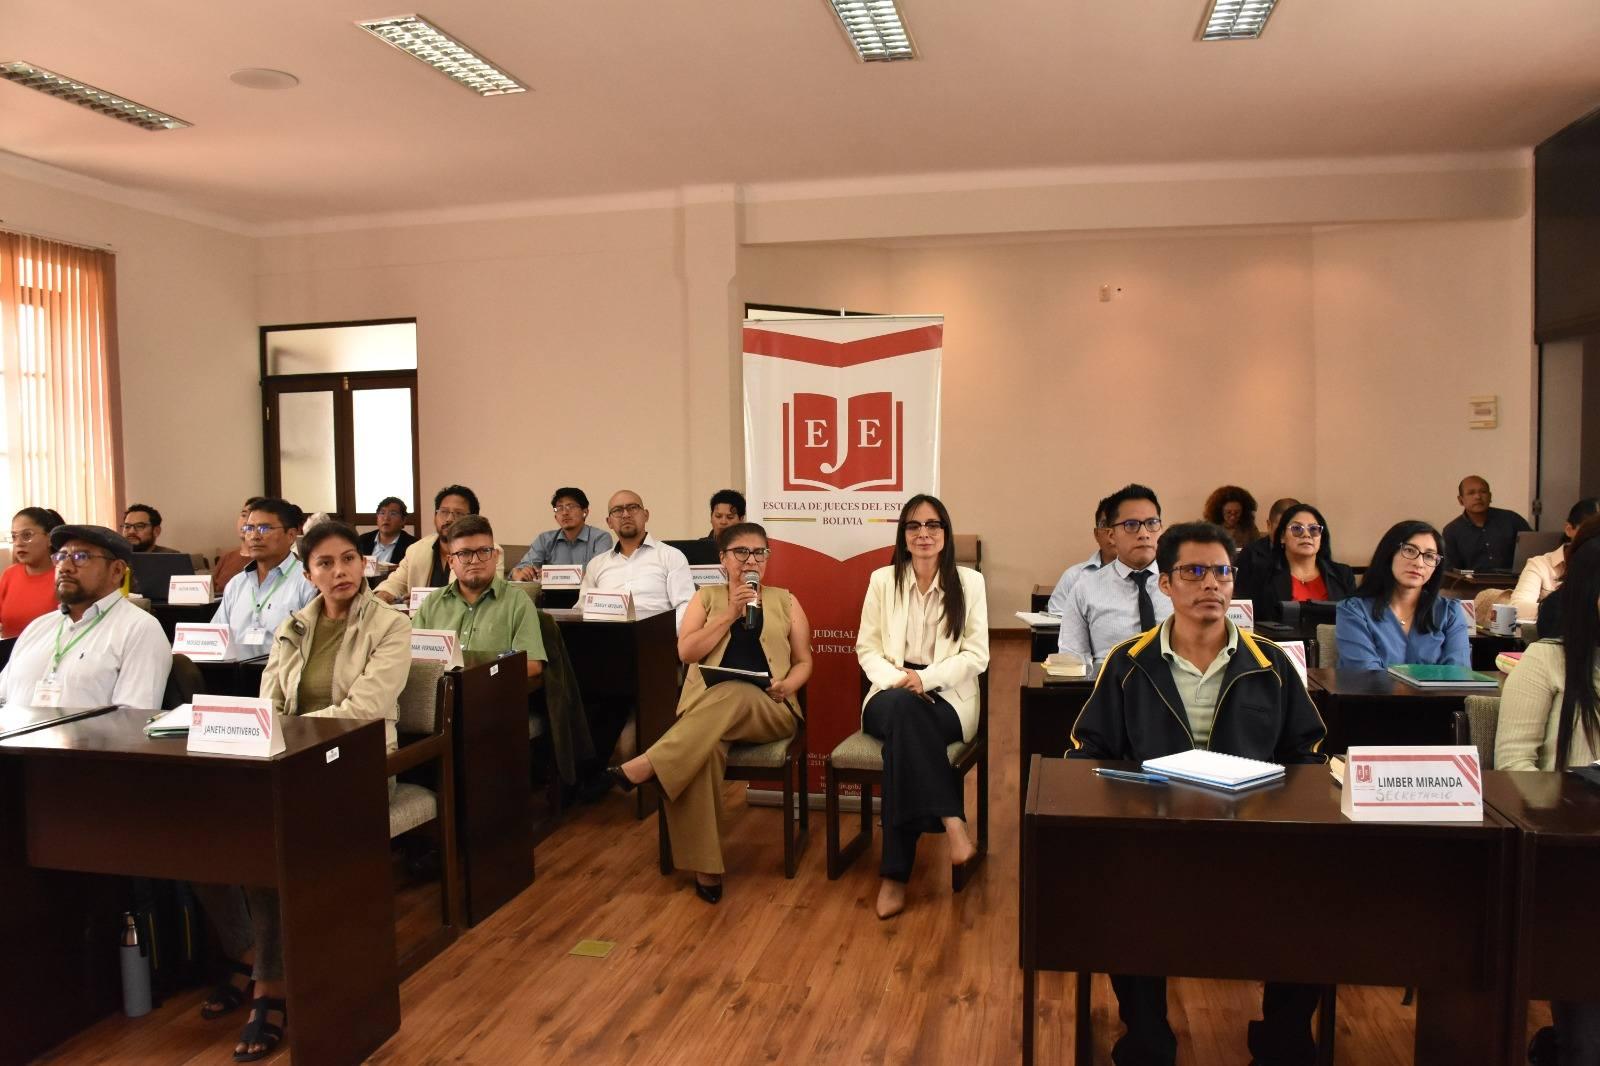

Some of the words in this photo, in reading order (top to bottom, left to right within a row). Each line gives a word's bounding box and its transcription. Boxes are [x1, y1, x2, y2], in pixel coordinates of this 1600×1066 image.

[763, 501, 806, 511] ESCUELA
[808, 502, 823, 511] DE
[823, 502, 860, 512] JUECES
[861, 502, 883, 511] DEL
[822, 517, 863, 526] BOLIVIA
[812, 629, 856, 639] JUDICIAL
[203, 725, 226, 736] JANETH
[226, 726, 260, 737] ONTIVEROS
[1378, 777, 1414, 788] LIMBER
[1416, 776, 1463, 788] MIRANDA
